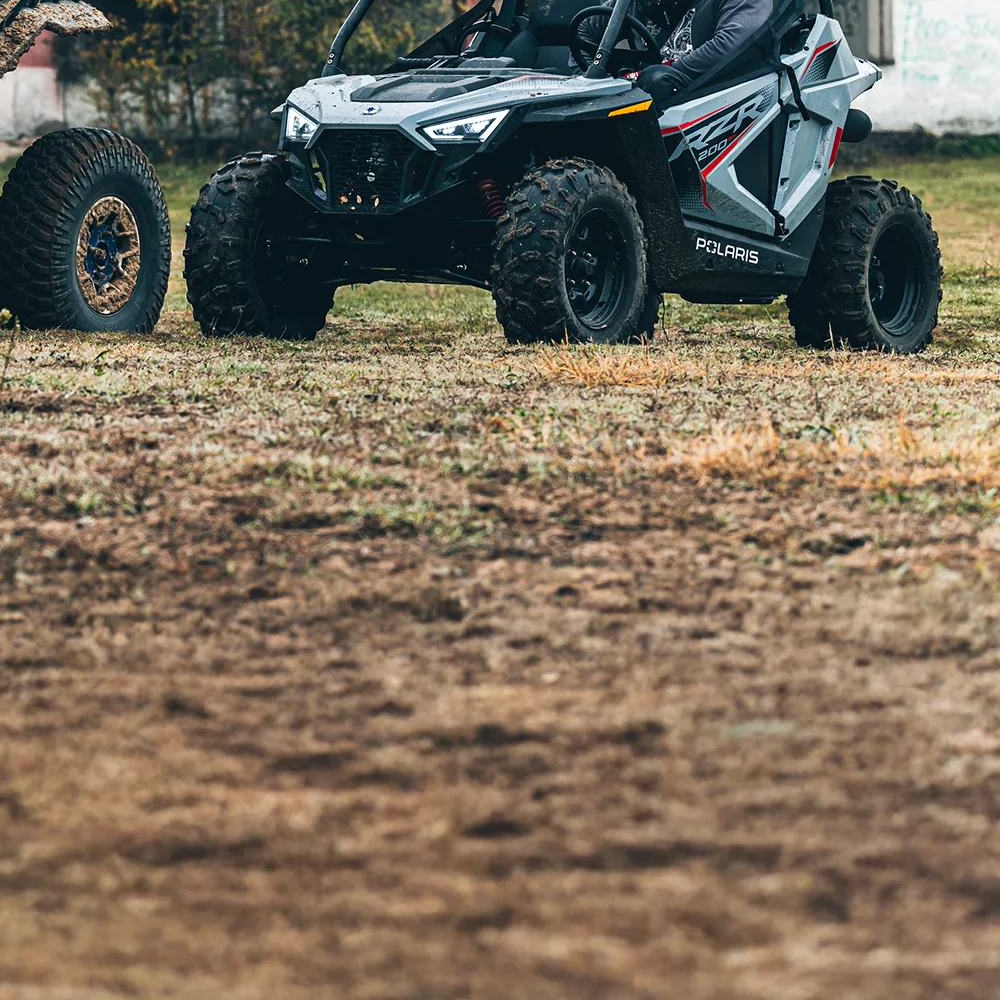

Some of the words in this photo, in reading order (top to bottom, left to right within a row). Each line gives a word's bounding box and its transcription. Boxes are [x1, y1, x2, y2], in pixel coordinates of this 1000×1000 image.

[668, 94, 765, 162] RZR
[698, 138, 728, 161] 200
[696, 237, 758, 264] POLARIS
